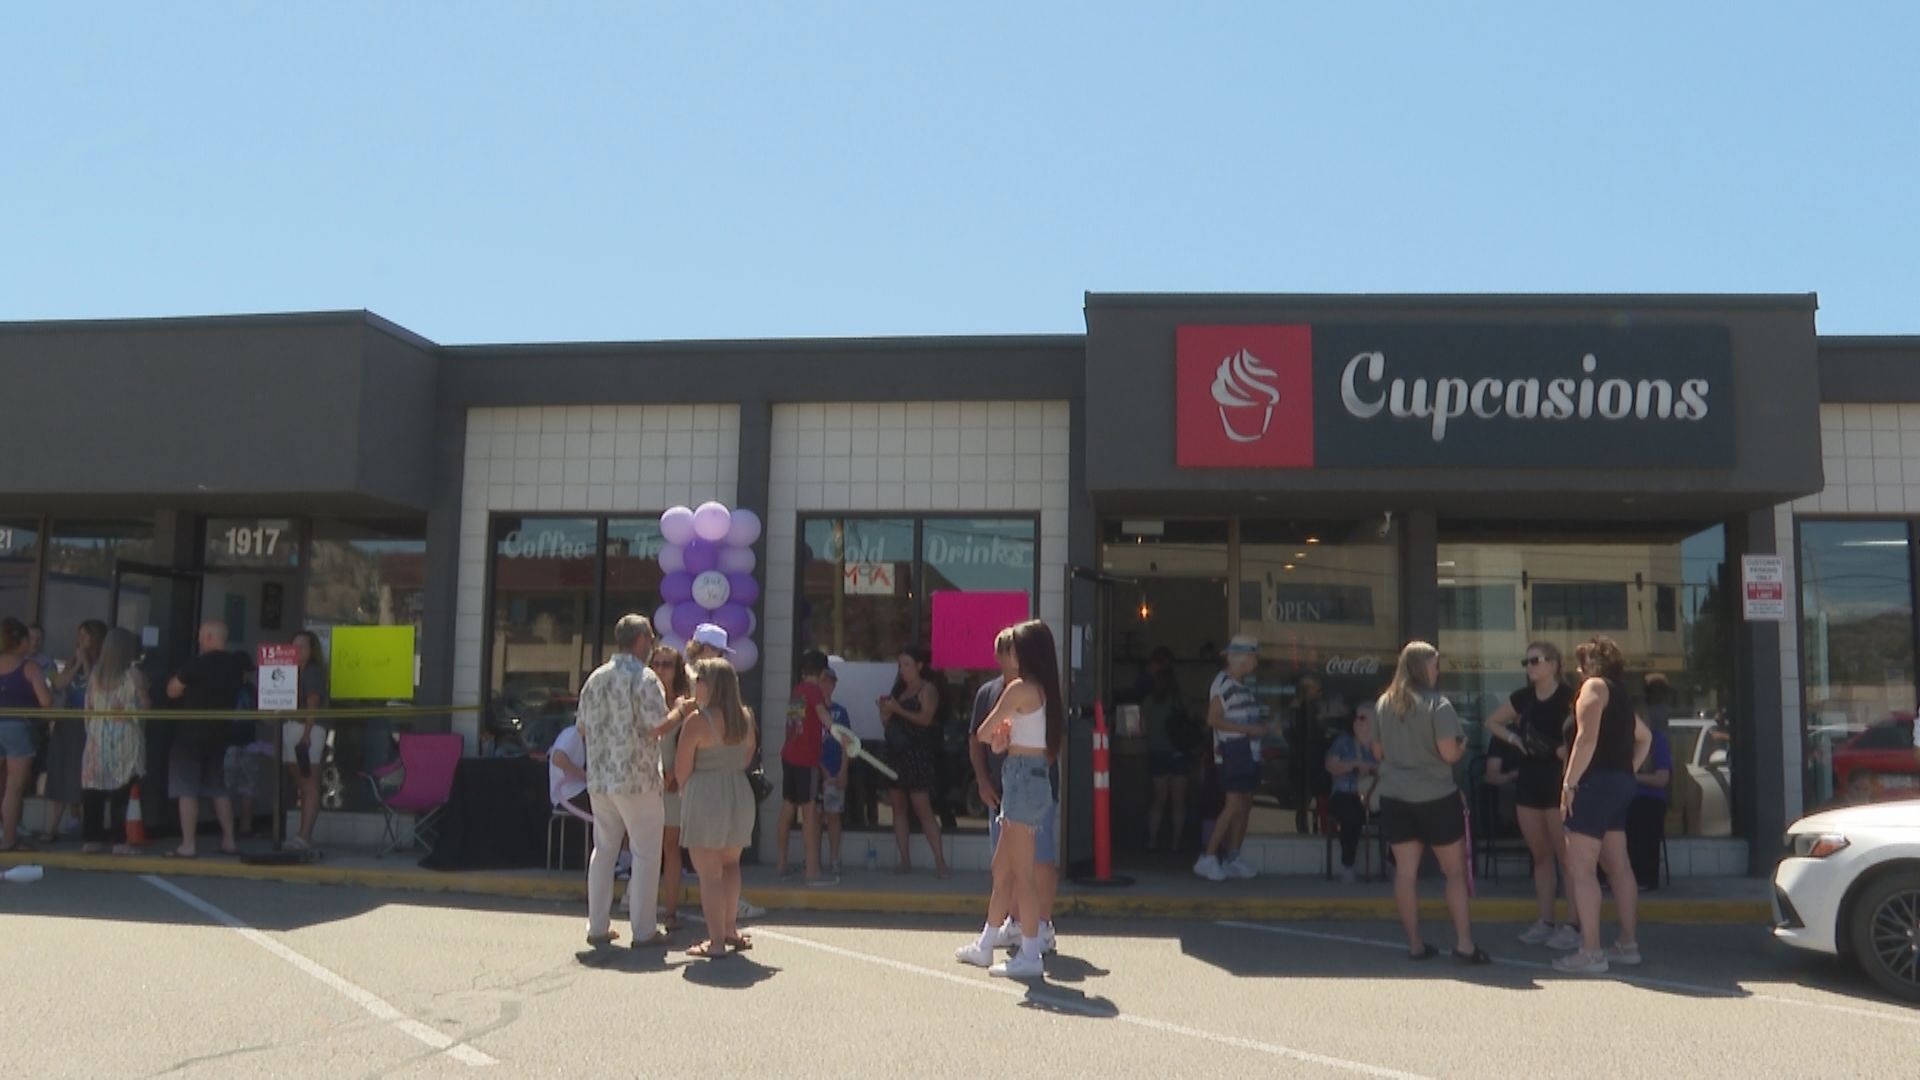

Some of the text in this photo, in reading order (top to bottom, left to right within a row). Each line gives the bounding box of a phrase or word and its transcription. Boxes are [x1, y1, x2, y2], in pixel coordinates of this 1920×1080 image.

[1340, 351, 1710, 442] Cupcasions
[225, 526, 281, 556] 1917
[503, 529, 587, 560] Coffee
[633, 531, 662, 561] Te
[823, 535, 886, 563] Cold
[928, 534, 1026, 565] Drinks
[1267, 600, 1321, 623] OPEN
